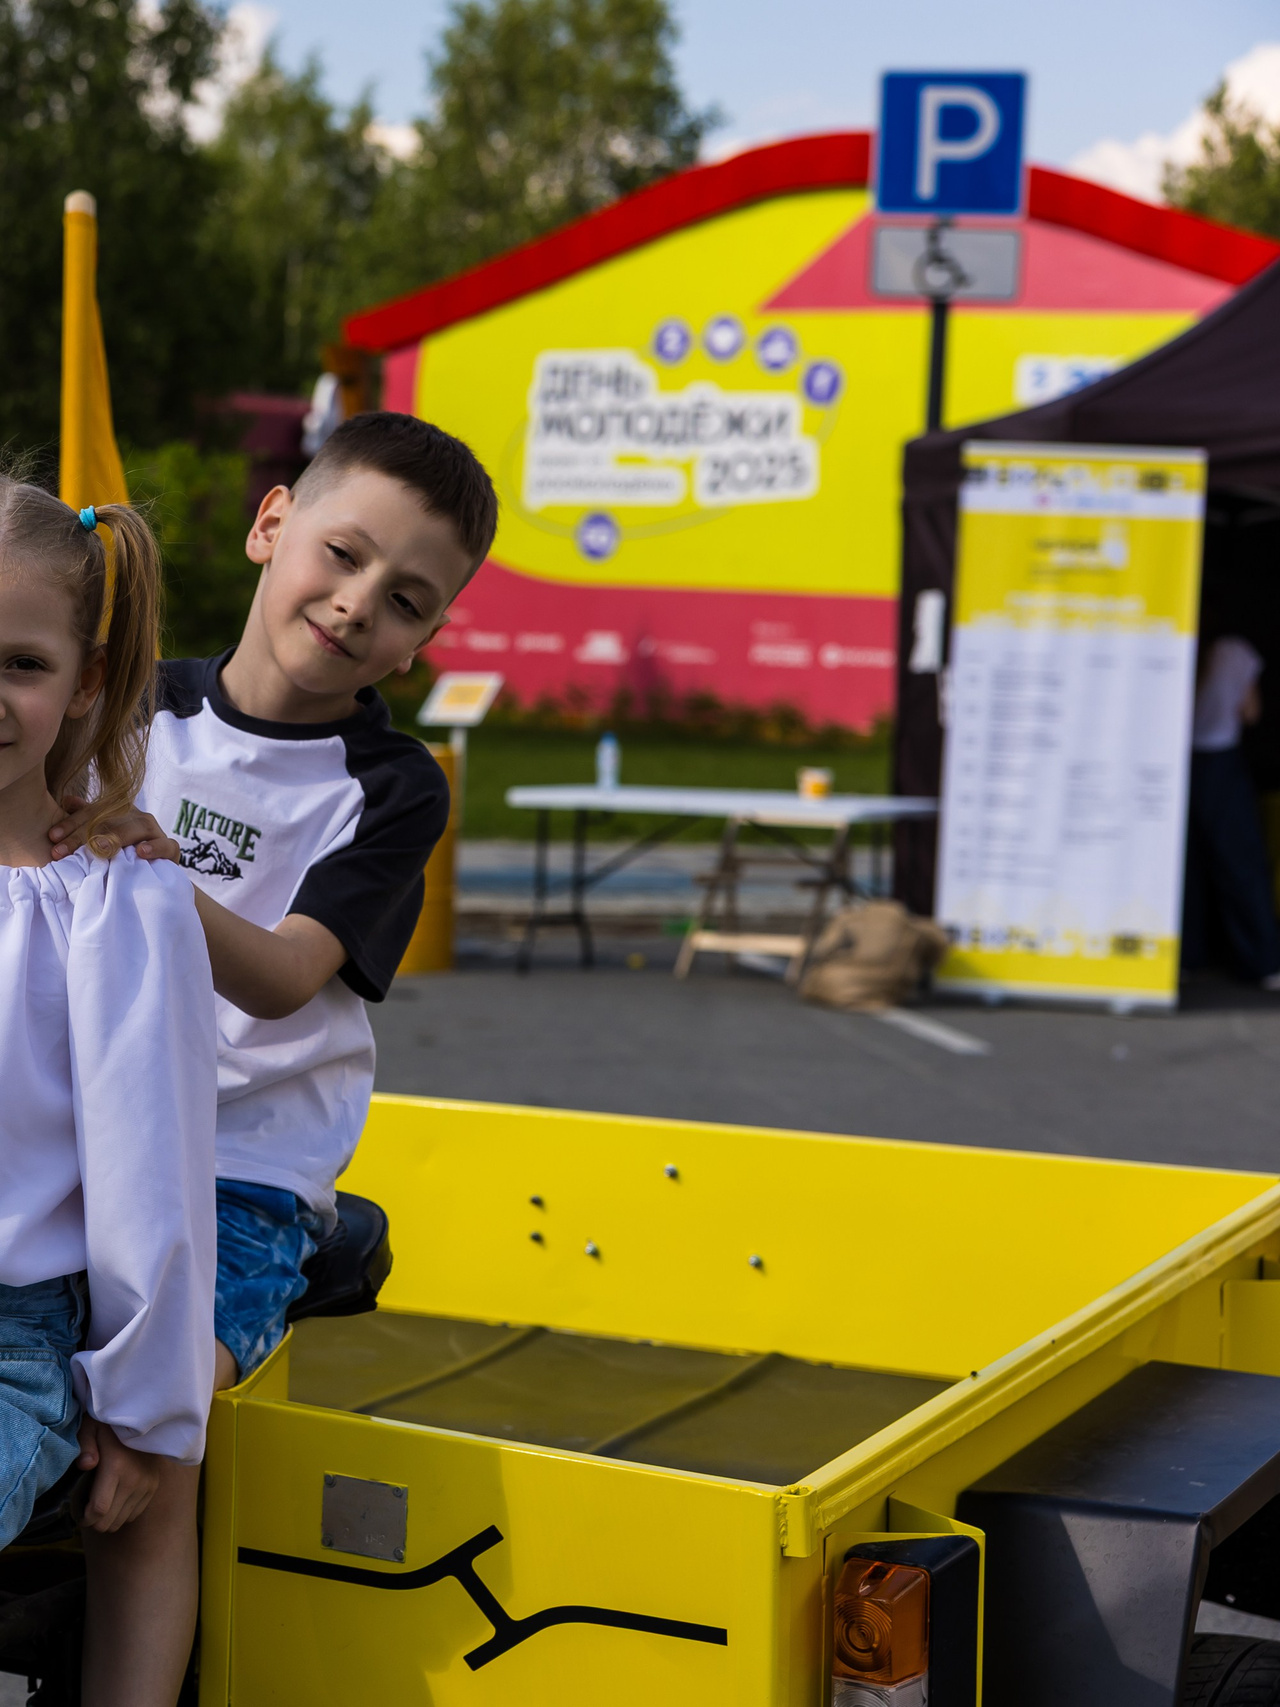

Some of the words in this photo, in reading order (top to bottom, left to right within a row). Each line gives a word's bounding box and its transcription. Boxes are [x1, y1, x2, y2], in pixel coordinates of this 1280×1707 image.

[915, 83, 1002, 202] P
[539, 364, 649, 402] ДЕНЬ
[707, 451, 810, 494] 2025
[173, 799, 262, 862] NATURE
